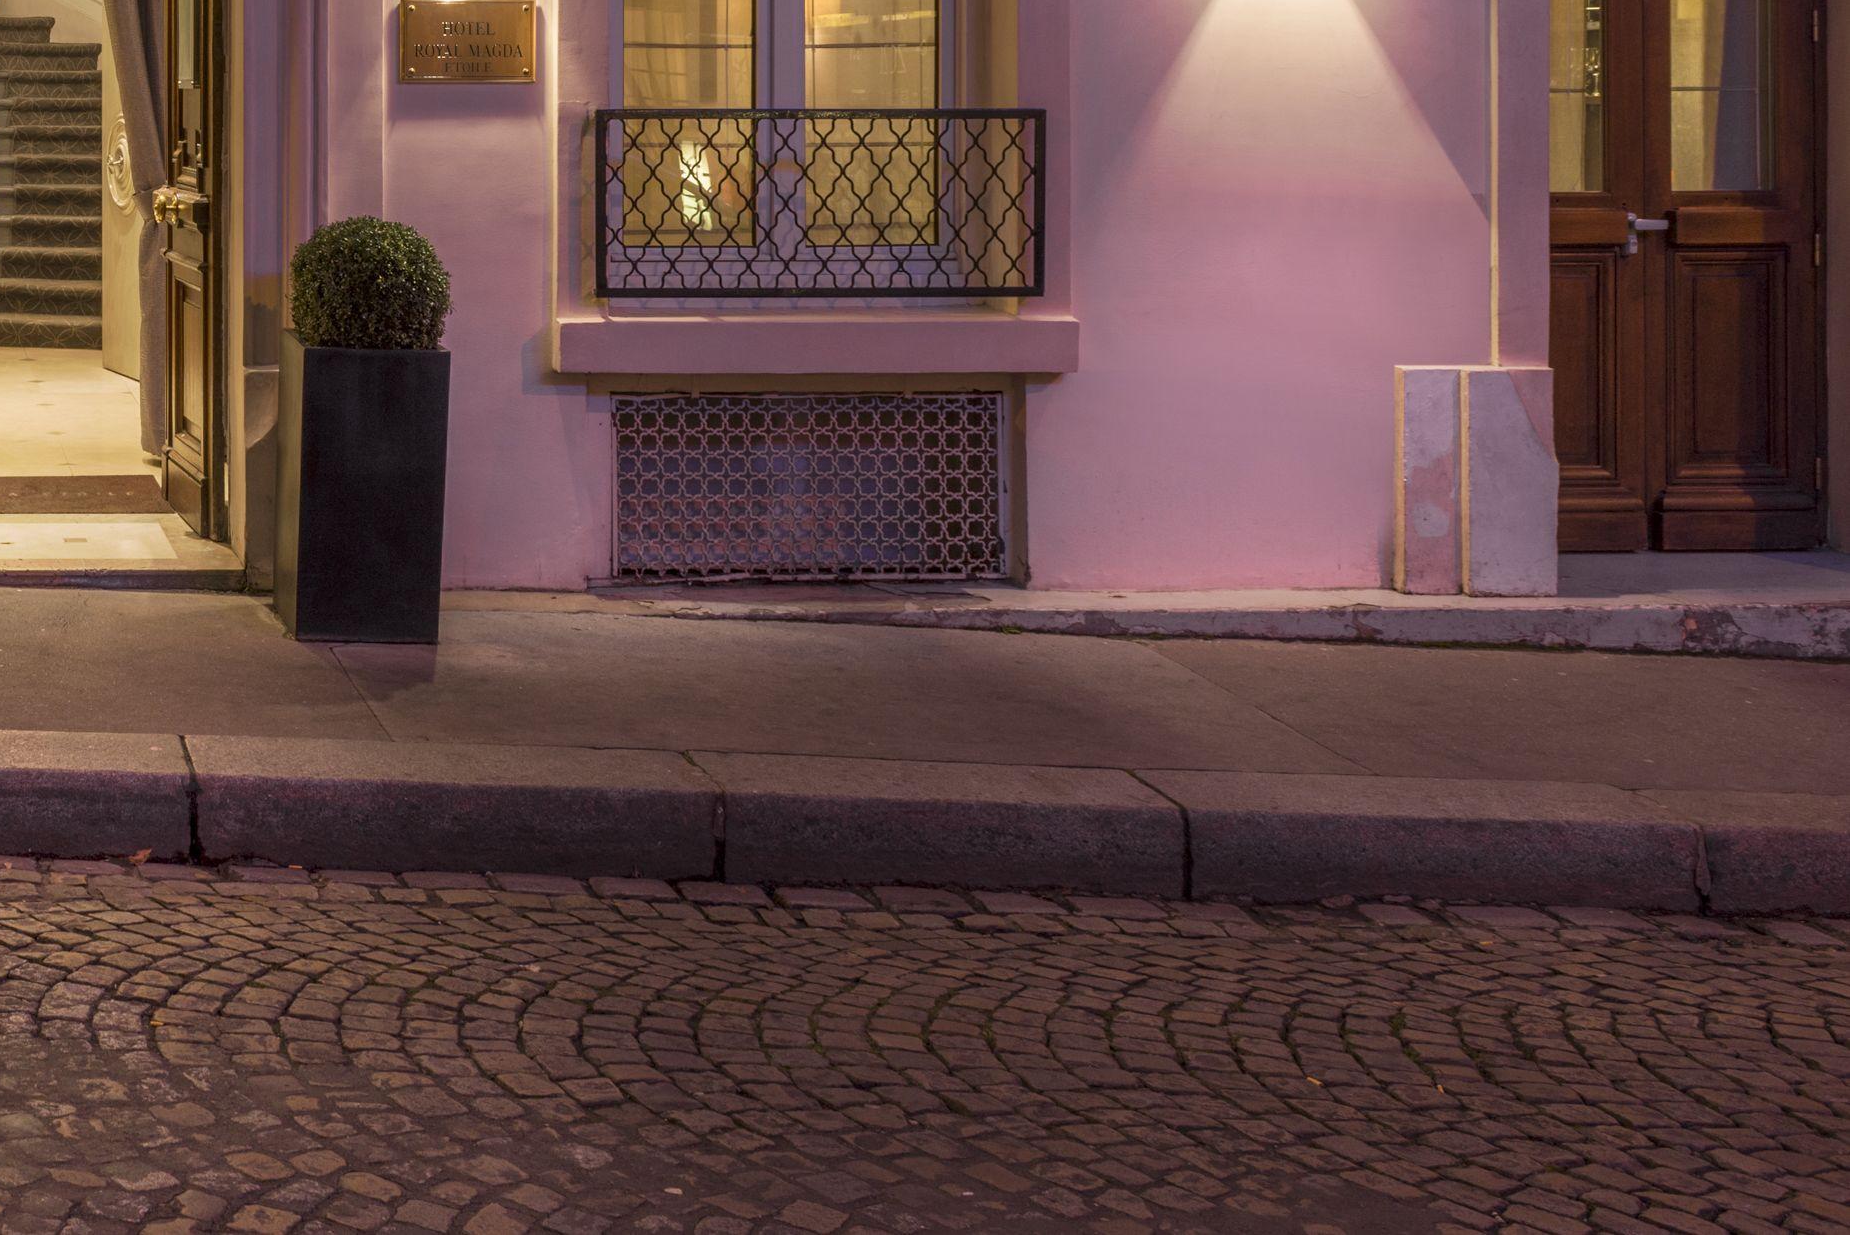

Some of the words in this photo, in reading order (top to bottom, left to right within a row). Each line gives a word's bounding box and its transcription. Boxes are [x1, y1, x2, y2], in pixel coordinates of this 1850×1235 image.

[441, 21, 496, 36] HOTEL
[413, 43, 460, 58] ROYAL
[468, 43, 523, 58] MAGDA
